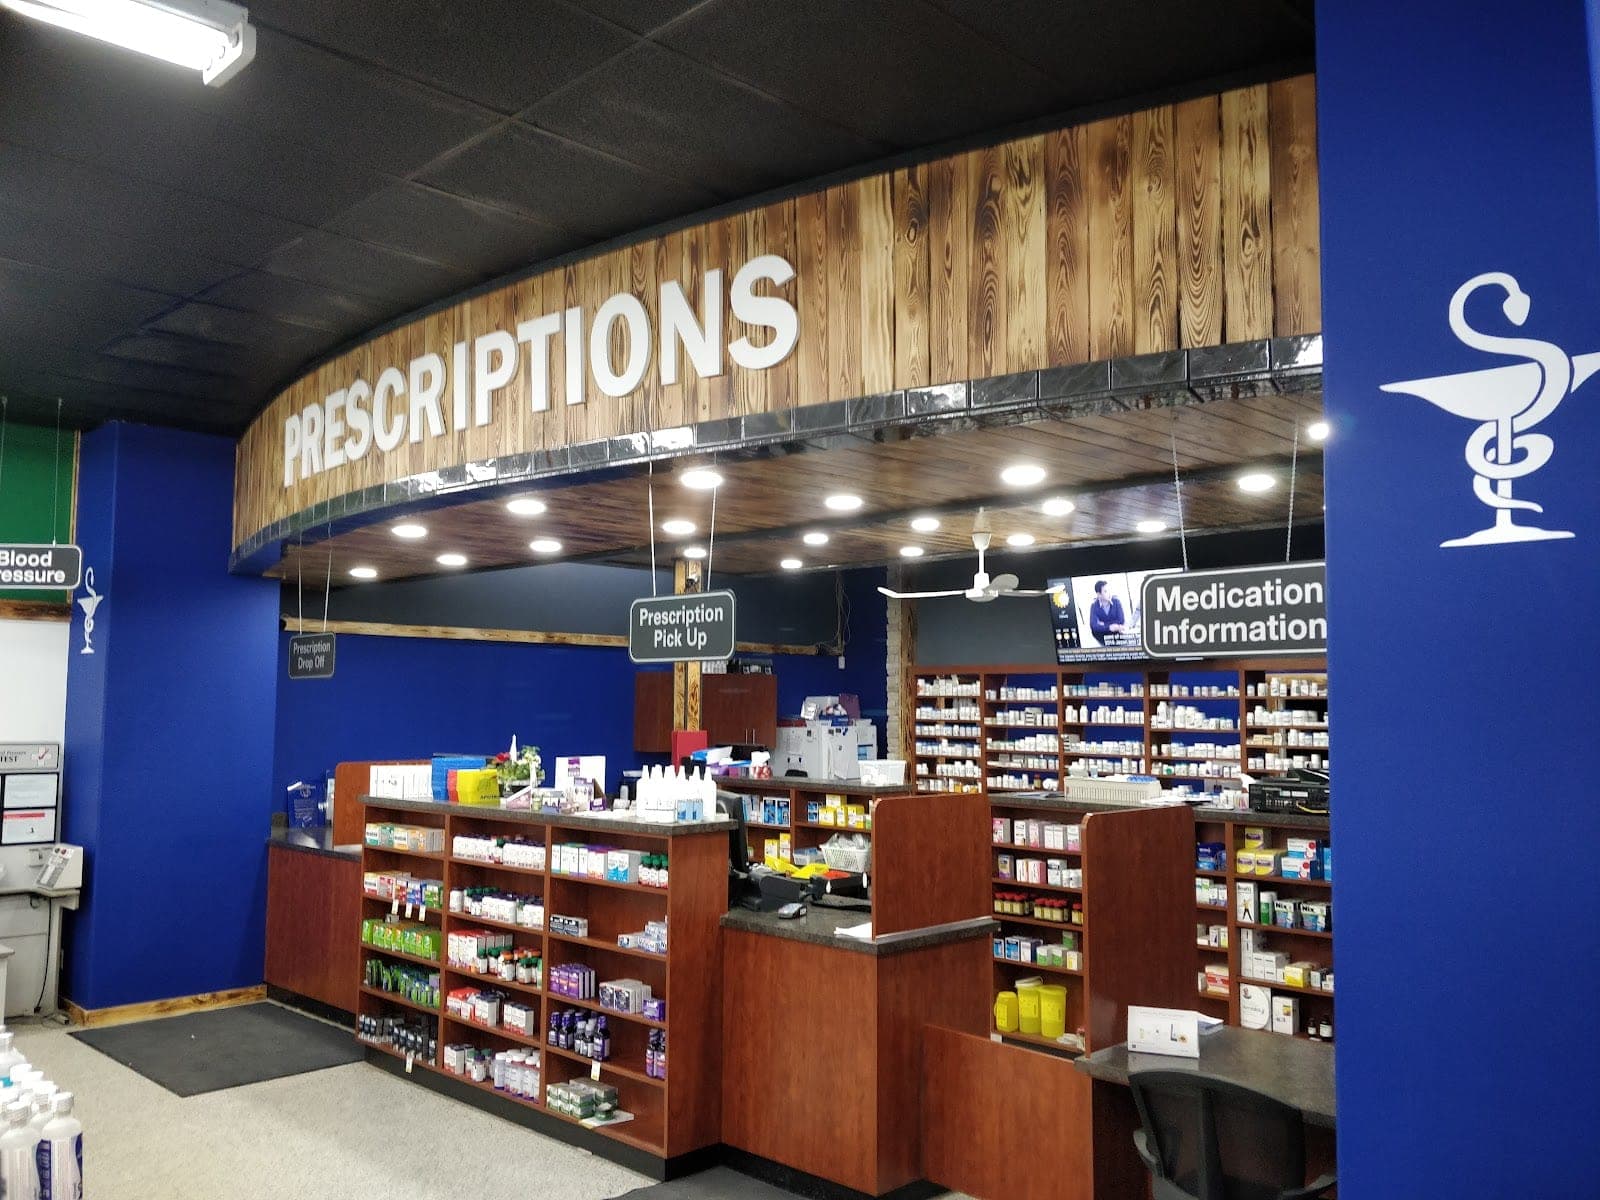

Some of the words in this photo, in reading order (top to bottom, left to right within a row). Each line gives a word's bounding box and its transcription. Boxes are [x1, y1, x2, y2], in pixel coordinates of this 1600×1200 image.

[284, 254, 799, 488] PRESCRIPTIONS
[0, 550, 52, 567] Blood
[0, 569, 66, 583] essure
[1156, 578, 1323, 612] Medication
[640, 603, 724, 628] Prescription
[654, 628, 682, 648] Pick
[686, 626, 707, 650] Up
[1154, 613, 1327, 645] Information
[293, 640, 331, 656] Prescription
[297, 656, 313, 671] Drop
[314, 655, 325, 668] Off
